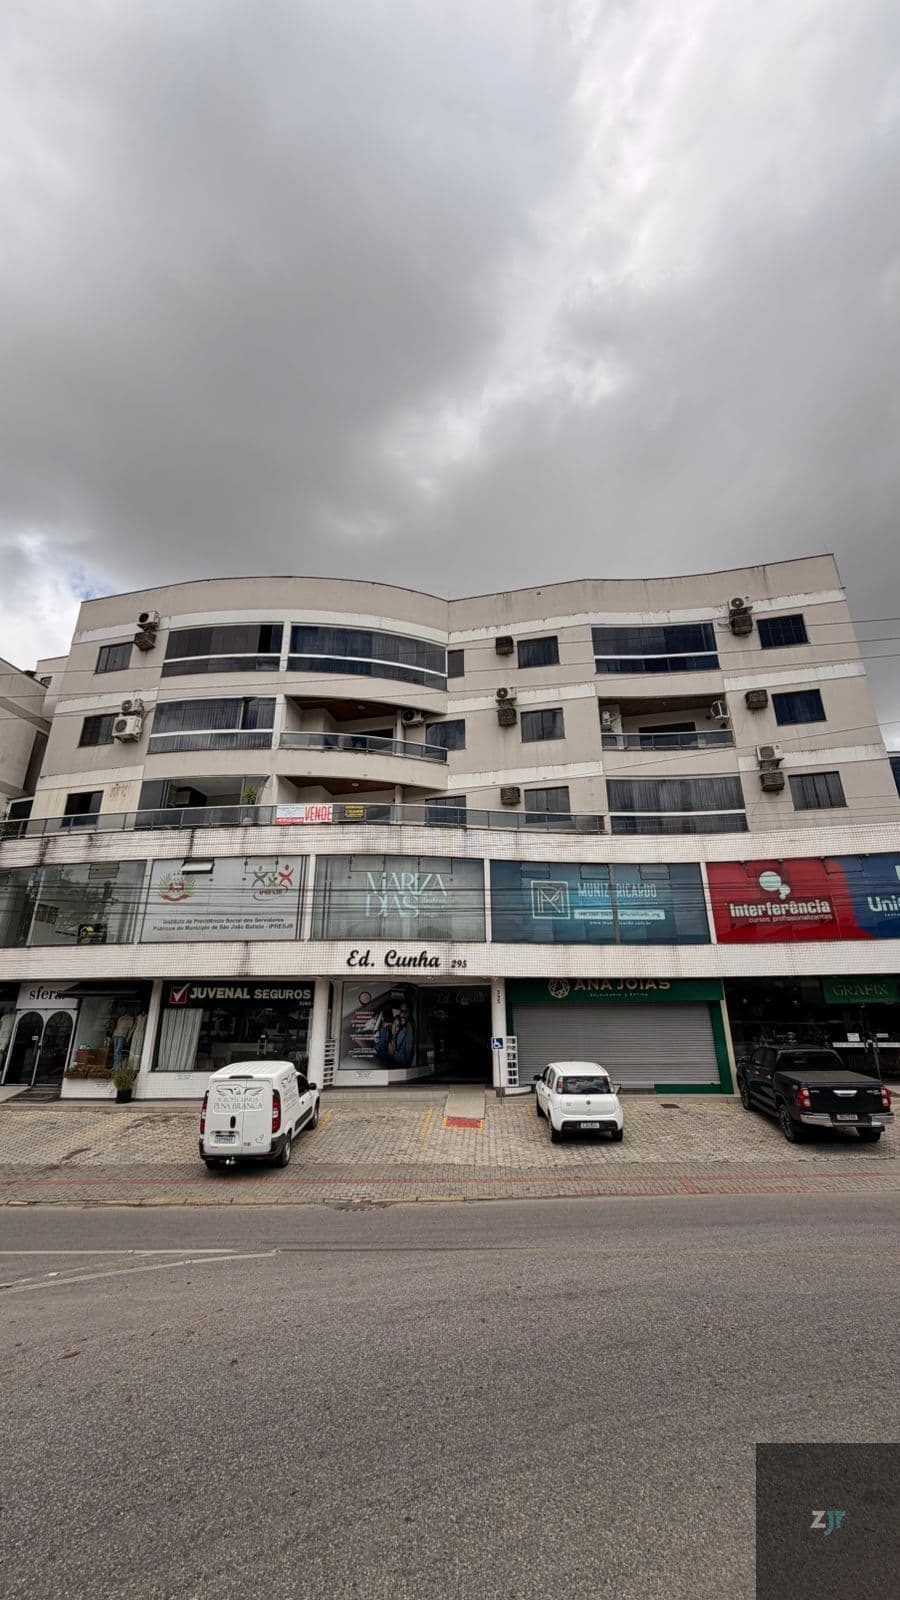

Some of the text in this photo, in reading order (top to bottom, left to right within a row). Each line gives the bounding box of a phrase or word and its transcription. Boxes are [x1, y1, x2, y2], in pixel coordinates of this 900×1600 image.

[305, 806, 333, 821] VENDE
[366, 872, 447, 896] MARIZA
[577, 883, 657, 898] MUNIZ RICARDO
[366, 894, 419, 918] DIAS
[729, 899, 831, 917] Interferência
[346, 949, 467, 968] Ed. Cunha 295
[574, 978, 671, 990] ANA JOIAS
[189, 987, 311, 1000] JUVENAL SEGUROS
